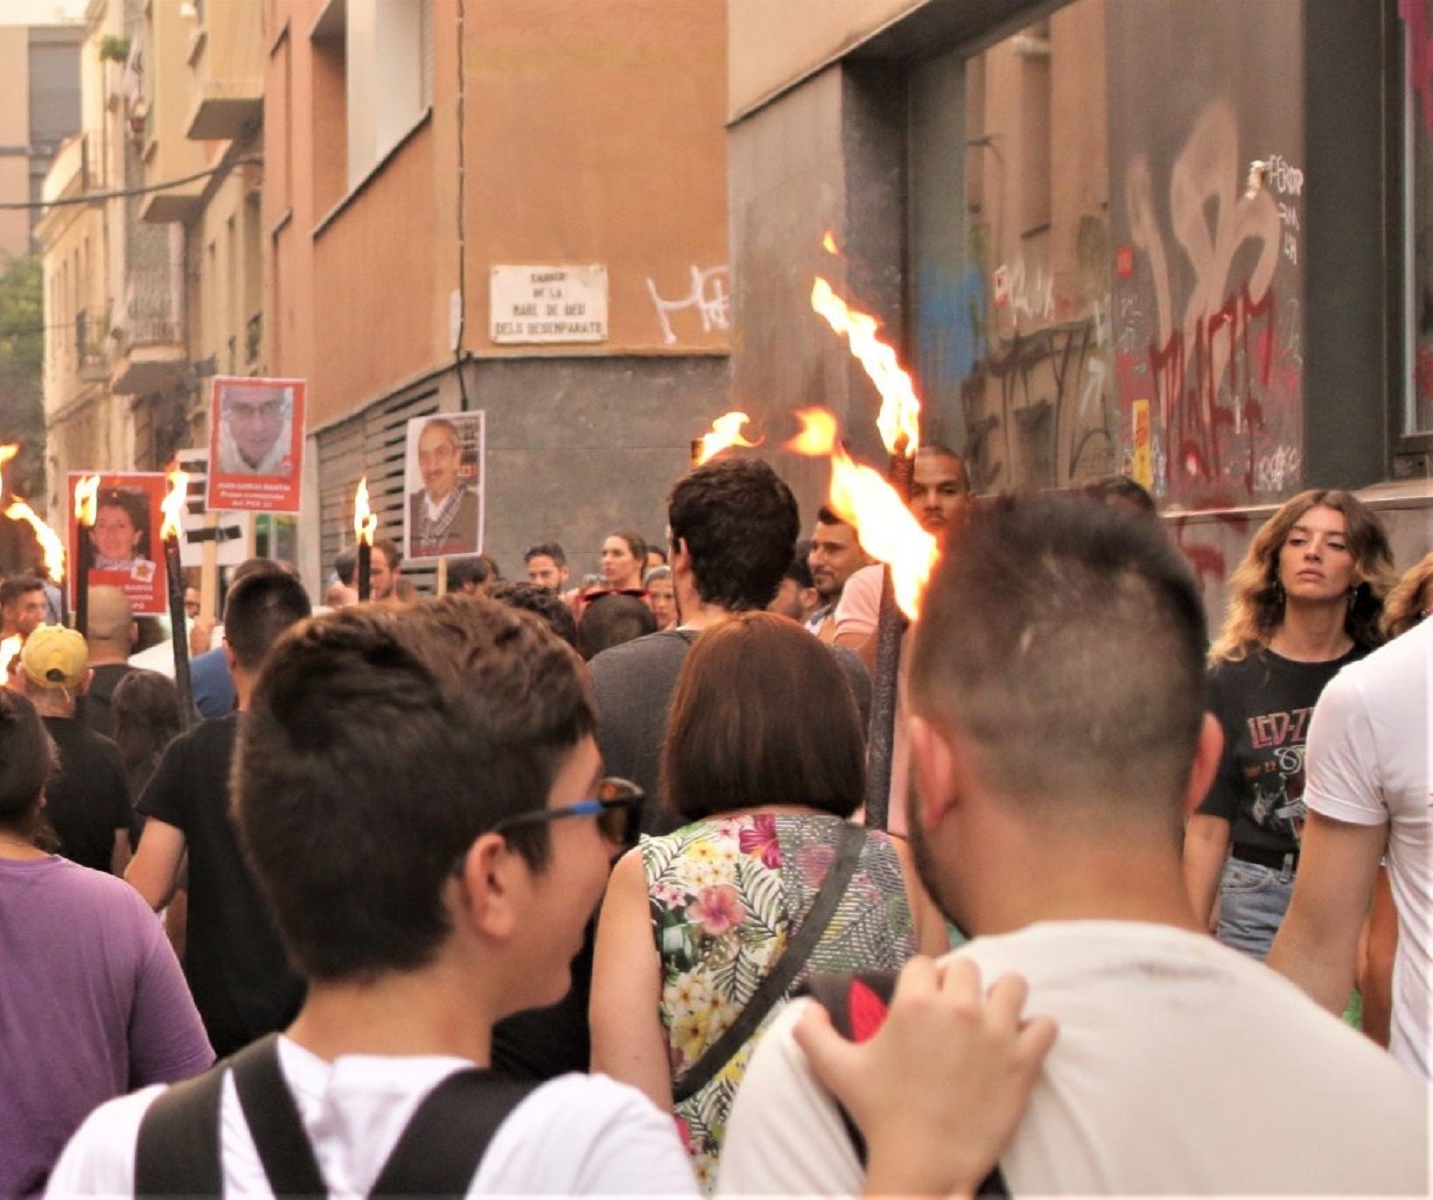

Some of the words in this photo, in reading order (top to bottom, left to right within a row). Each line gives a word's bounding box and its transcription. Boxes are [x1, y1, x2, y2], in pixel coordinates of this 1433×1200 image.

[549, 287, 563, 298] LA
[513, 303, 538, 316] MARE
[547, 303, 559, 316] DE
[495, 321, 524, 335] DELS
[527, 321, 602, 334] DESEMPARATS
[1247, 706, 1316, 749] LED-Z
